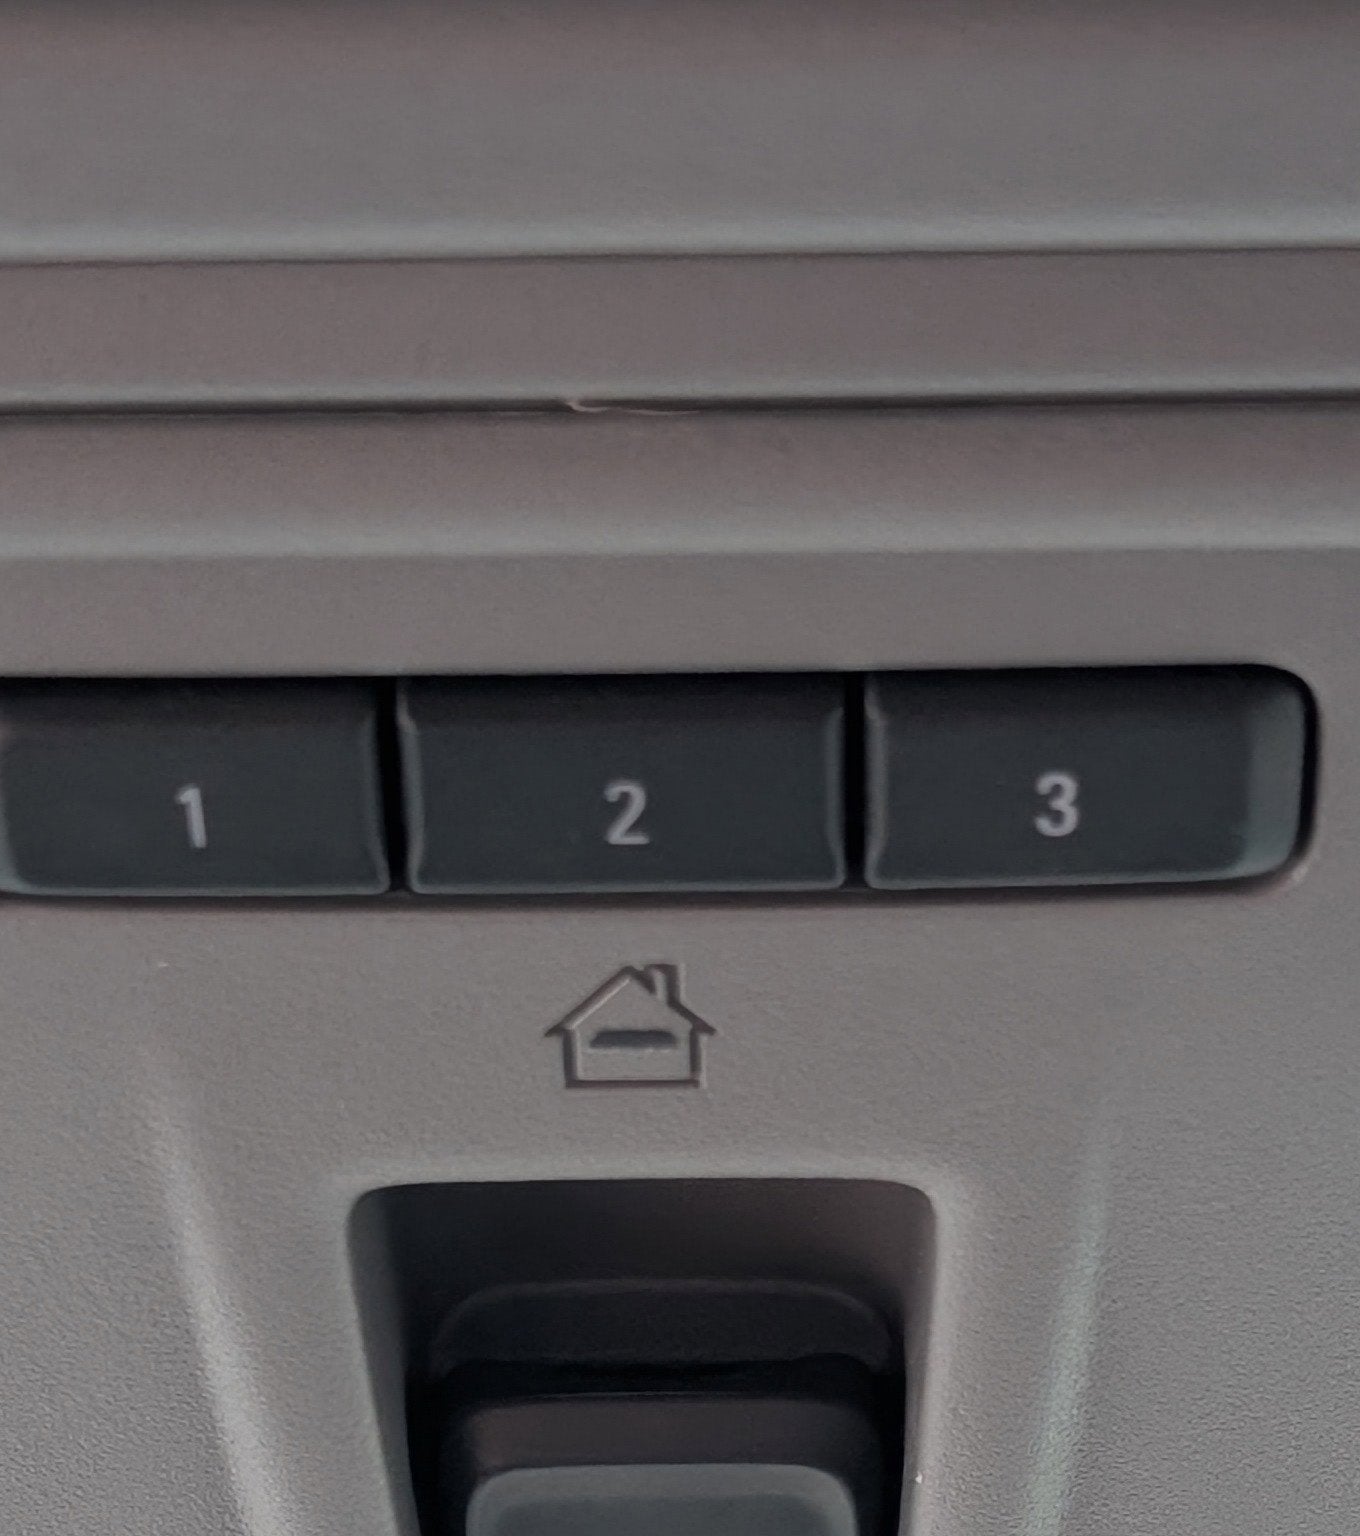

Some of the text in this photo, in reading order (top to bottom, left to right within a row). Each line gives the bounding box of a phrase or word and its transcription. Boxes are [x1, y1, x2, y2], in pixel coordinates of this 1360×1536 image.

[178, 785, 208, 850] 1
[604, 784, 650, 845] 2
[1034, 773, 1080, 837] 3
